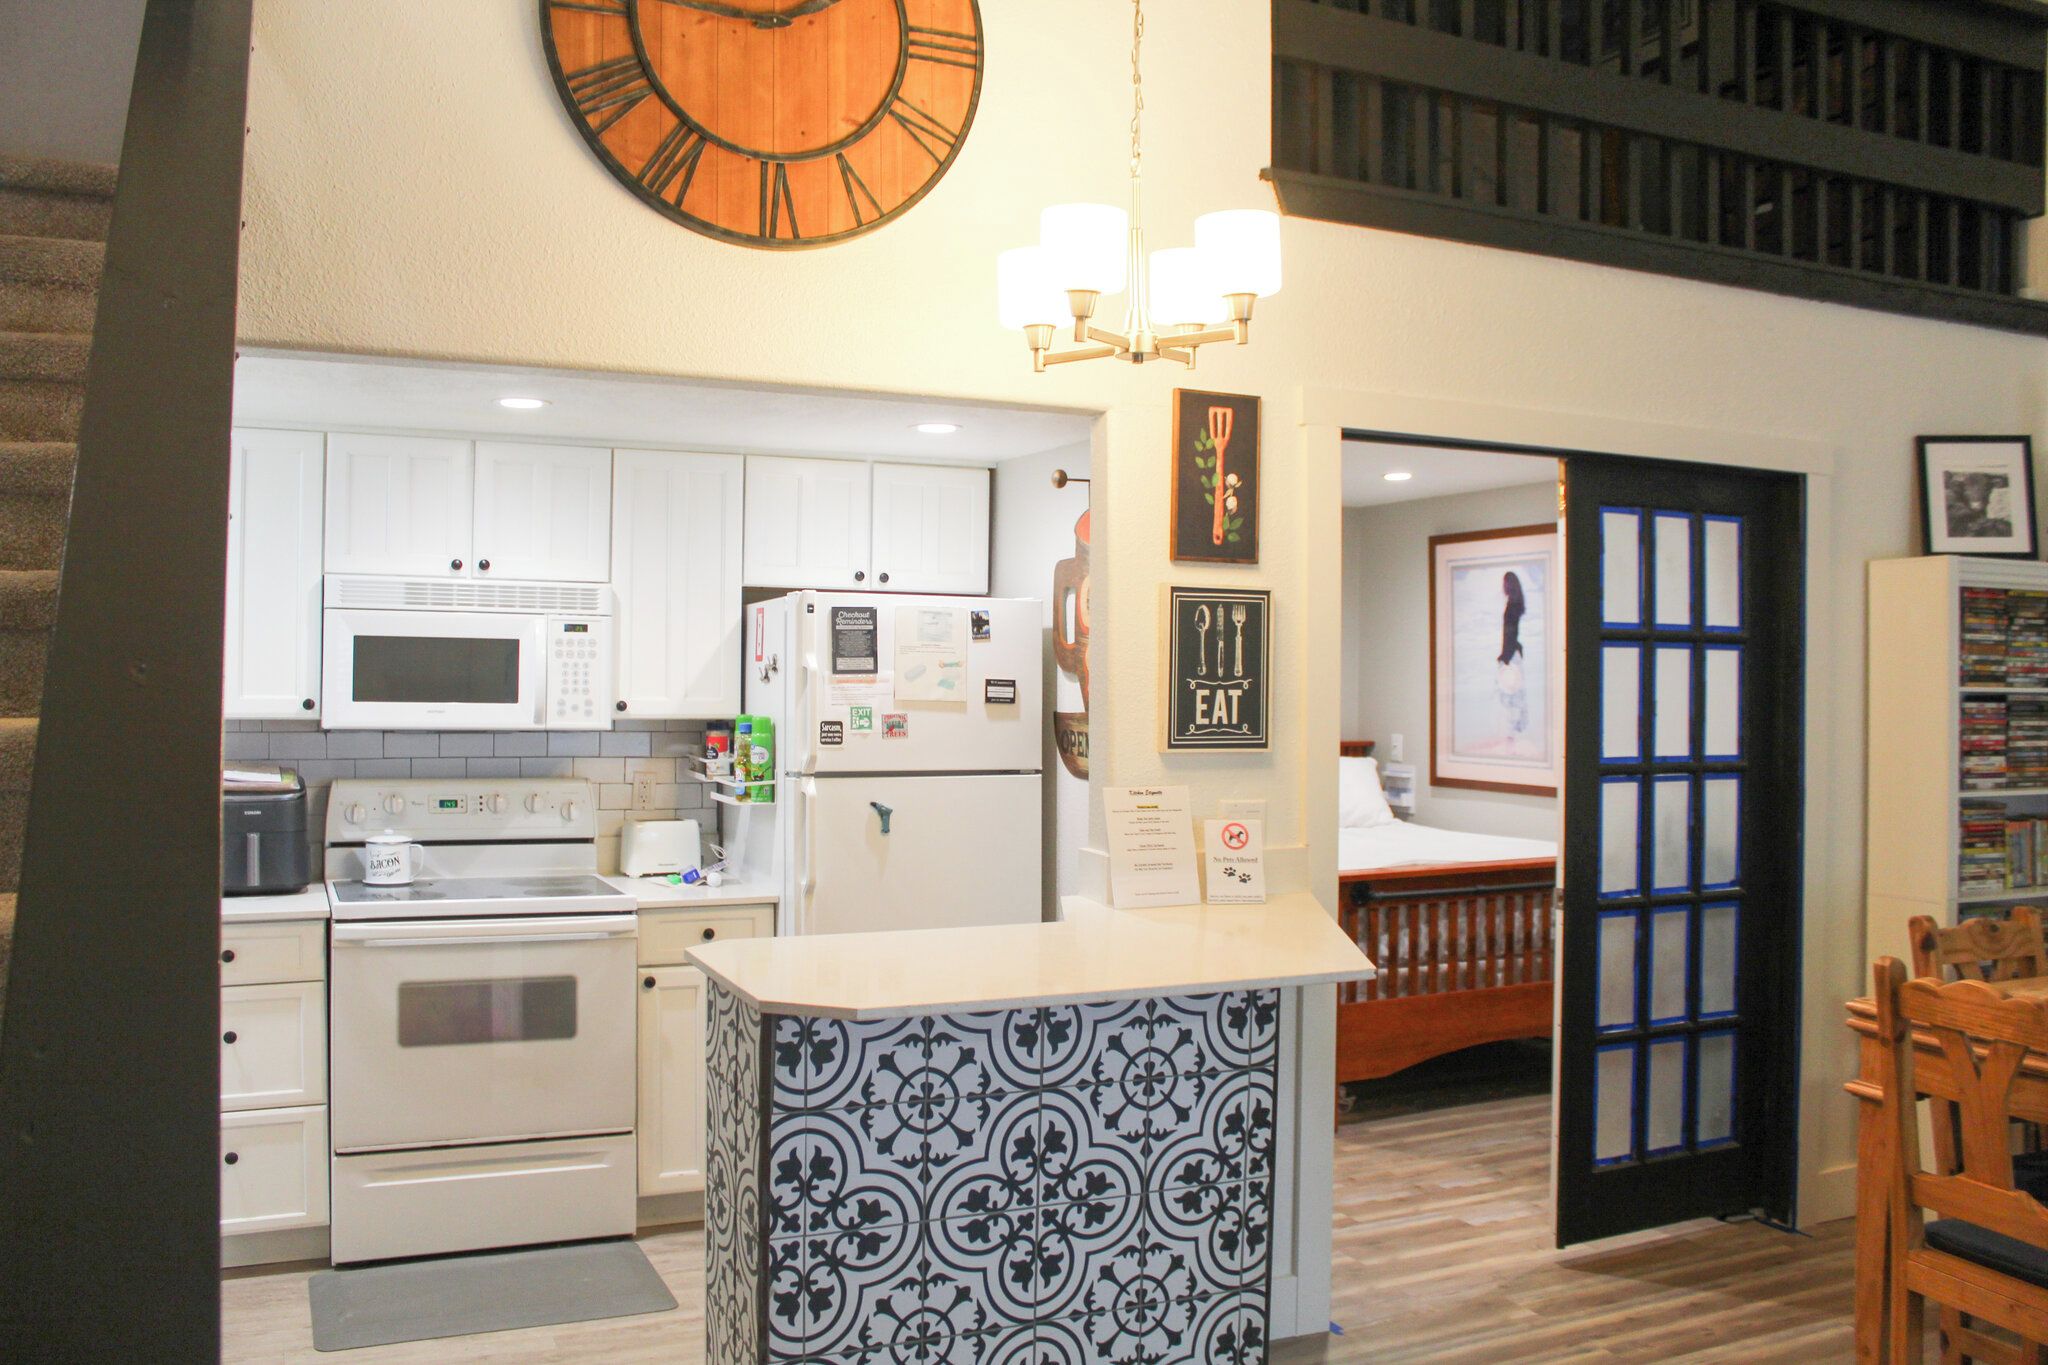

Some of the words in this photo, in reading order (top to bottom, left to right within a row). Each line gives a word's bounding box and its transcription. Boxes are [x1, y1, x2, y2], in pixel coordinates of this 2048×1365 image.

[836, 618, 872, 626] Reminders
[1195, 689, 1242, 725] EAT
[852, 708, 870, 717] EXIT
[821, 722, 842, 732] Sarcasm,
[370, 856, 400, 869] BACON
